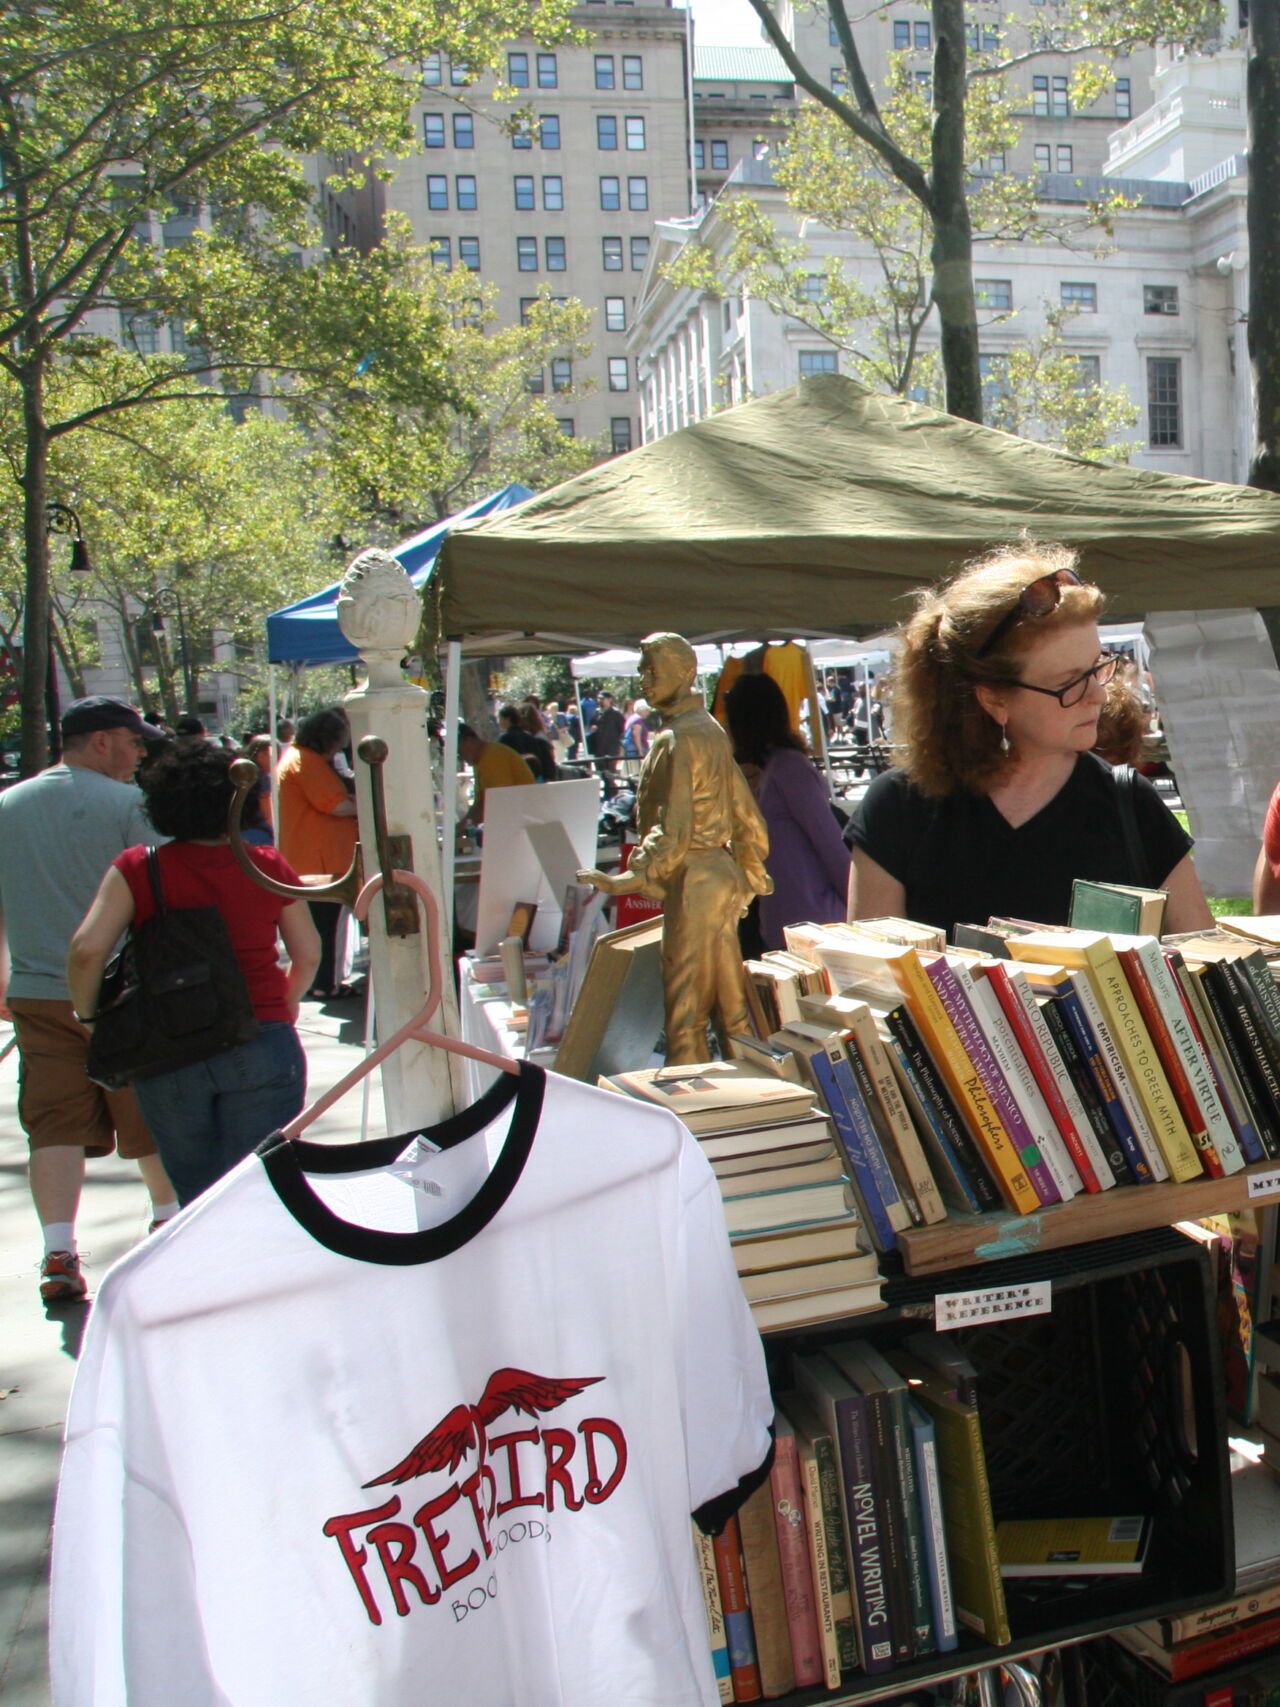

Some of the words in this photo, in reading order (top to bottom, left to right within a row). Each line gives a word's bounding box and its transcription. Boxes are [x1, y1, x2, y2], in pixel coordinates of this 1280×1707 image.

[625, 898, 662, 909] ANSWER
[1144, 950, 1175, 999] MacIntyre
[1259, 964, 1273, 985] The
[1016, 981, 1042, 1023] PLATO
[1034, 1023, 1069, 1084] REPUBLIC
[1103, 975, 1145, 1048] APPROACHES
[912, 1051, 925, 1067] The
[929, 972, 948, 1000] AND
[942, 999, 974, 1053] CENTRAL
[969, 1056, 1000, 1106] AMERICA
[941, 968, 958, 992] THE
[952, 992, 993, 1064] MYTHOLOGY
[987, 1063, 1000, 1079] OF
[994, 1079, 1022, 1125] MEXICO
[990, 1035, 1012, 1071] MAYHEM
[992, 1016, 1039, 1098] potentialities
[1094, 1021, 1127, 1082] EMPIRICISM
[1135, 1048, 1150, 1066] TO
[1236, 1004, 1260, 1047] HEGEL'S
[1254, 1047, 1280, 1099] DIALECTIC
[918, 1066, 946, 1111] Philosophy
[1141, 1067, 1165, 1103] GREEK
[1168, 1015, 1201, 1067] AFTER
[1189, 1067, 1224, 1124] VIRTUE
[941, 1108, 951, 1119] of
[945, 1118, 965, 1147] Science
[959, 1075, 1009, 1153] Philosophers
[1156, 1104, 1177, 1136] MYTH
[863, 1134, 873, 1145] ON
[1068, 1132, 1083, 1157] HACKETT
[944, 1287, 1030, 1308] WRITER'S
[945, 1297, 1044, 1321] REFERENCE
[851, 1483, 877, 1543] NOVEL
[812, 1521, 825, 1558] WRITING
[452, 1575, 498, 1624] BOO
[816, 1570, 833, 1633] RESTAURANTS
[859, 1546, 887, 1625] WRITING
